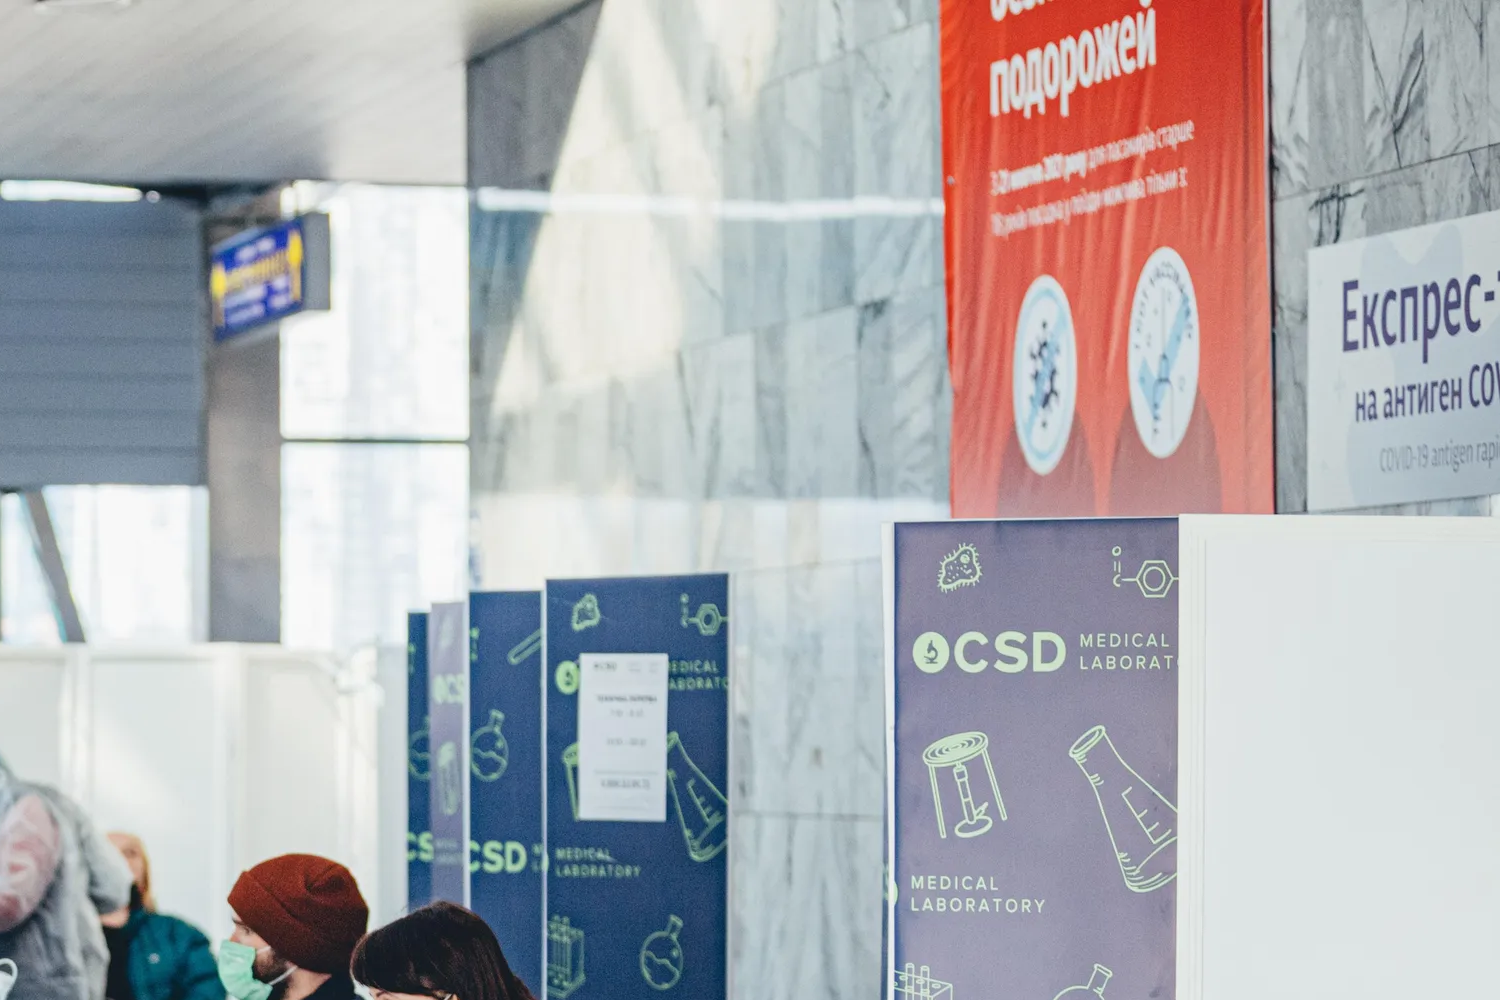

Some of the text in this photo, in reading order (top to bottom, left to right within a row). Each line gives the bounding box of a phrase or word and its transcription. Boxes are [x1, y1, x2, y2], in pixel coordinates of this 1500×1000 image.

[990, 0, 1156, 119] подорожей
[1156, 120, 1194, 151] старше
[1342, 270, 1500, 364] Експрес-
[1355, 389, 1378, 423] на
[1383, 376, 1463, 420] антиген
[1379, 443, 1429, 473] COVID-19
[1431, 438, 1474, 473] antigen
[954, 631, 1067, 674] CSD
[1079, 633, 1170, 648] MEDICAL
[1079, 655, 1179, 671] LABORAT
[555, 846, 611, 861] MEDICAL
[555, 864, 642, 878] LABORATORY
[910, 875, 999, 891] MEDICAL
[910, 897, 1046, 914] LABORATORY
